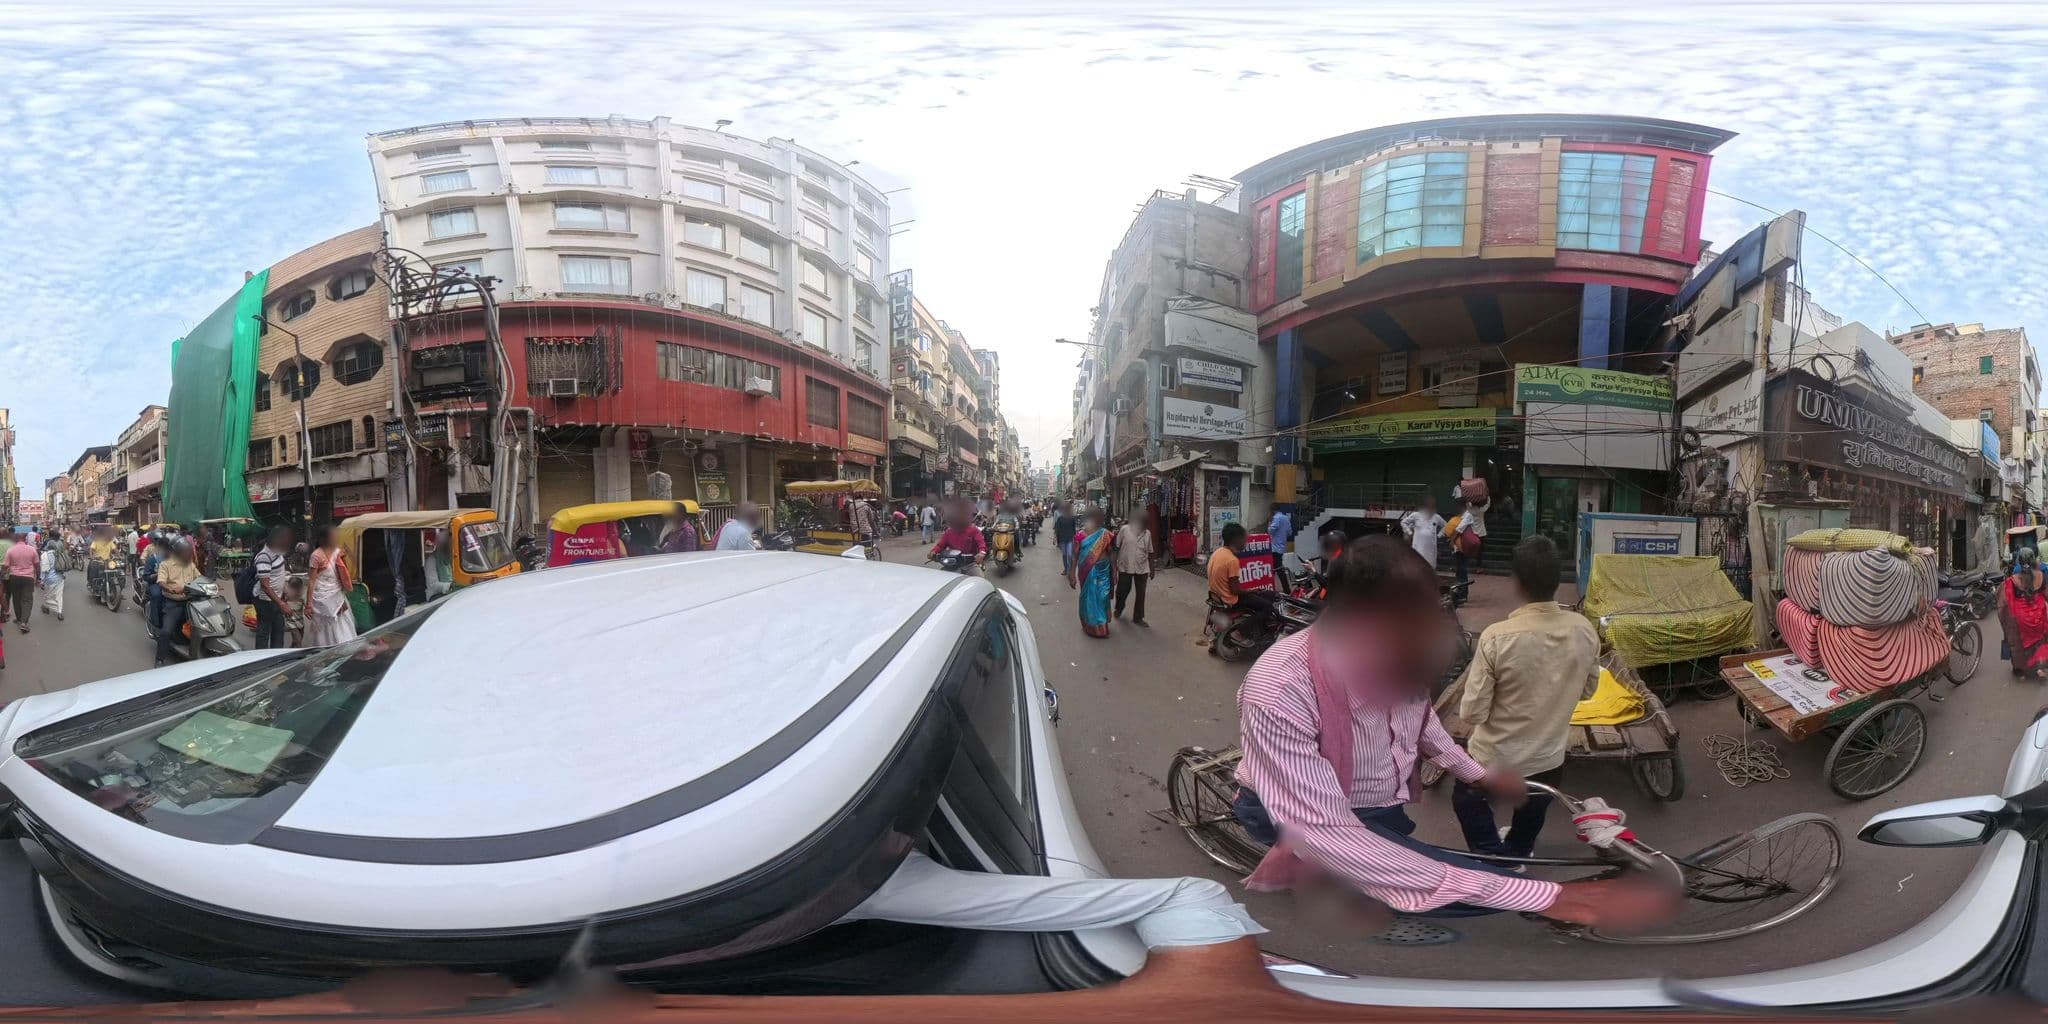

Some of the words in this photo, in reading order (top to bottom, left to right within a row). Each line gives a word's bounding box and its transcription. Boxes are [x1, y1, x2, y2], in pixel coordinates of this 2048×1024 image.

[1522, 366, 1559, 380] ATM
[1564, 379, 1582, 388] KVB
[1591, 381, 1613, 389] Karur
[1797, 385, 1923, 455] UNIVERSAL
[1407, 421, 1433, 430] Karur
[1434, 420, 1462, 431] Vysya
[1463, 419, 1488, 428] Bank
[1221, 512, 1232, 520] 50
[1645, 542, 1677, 551] CSH
